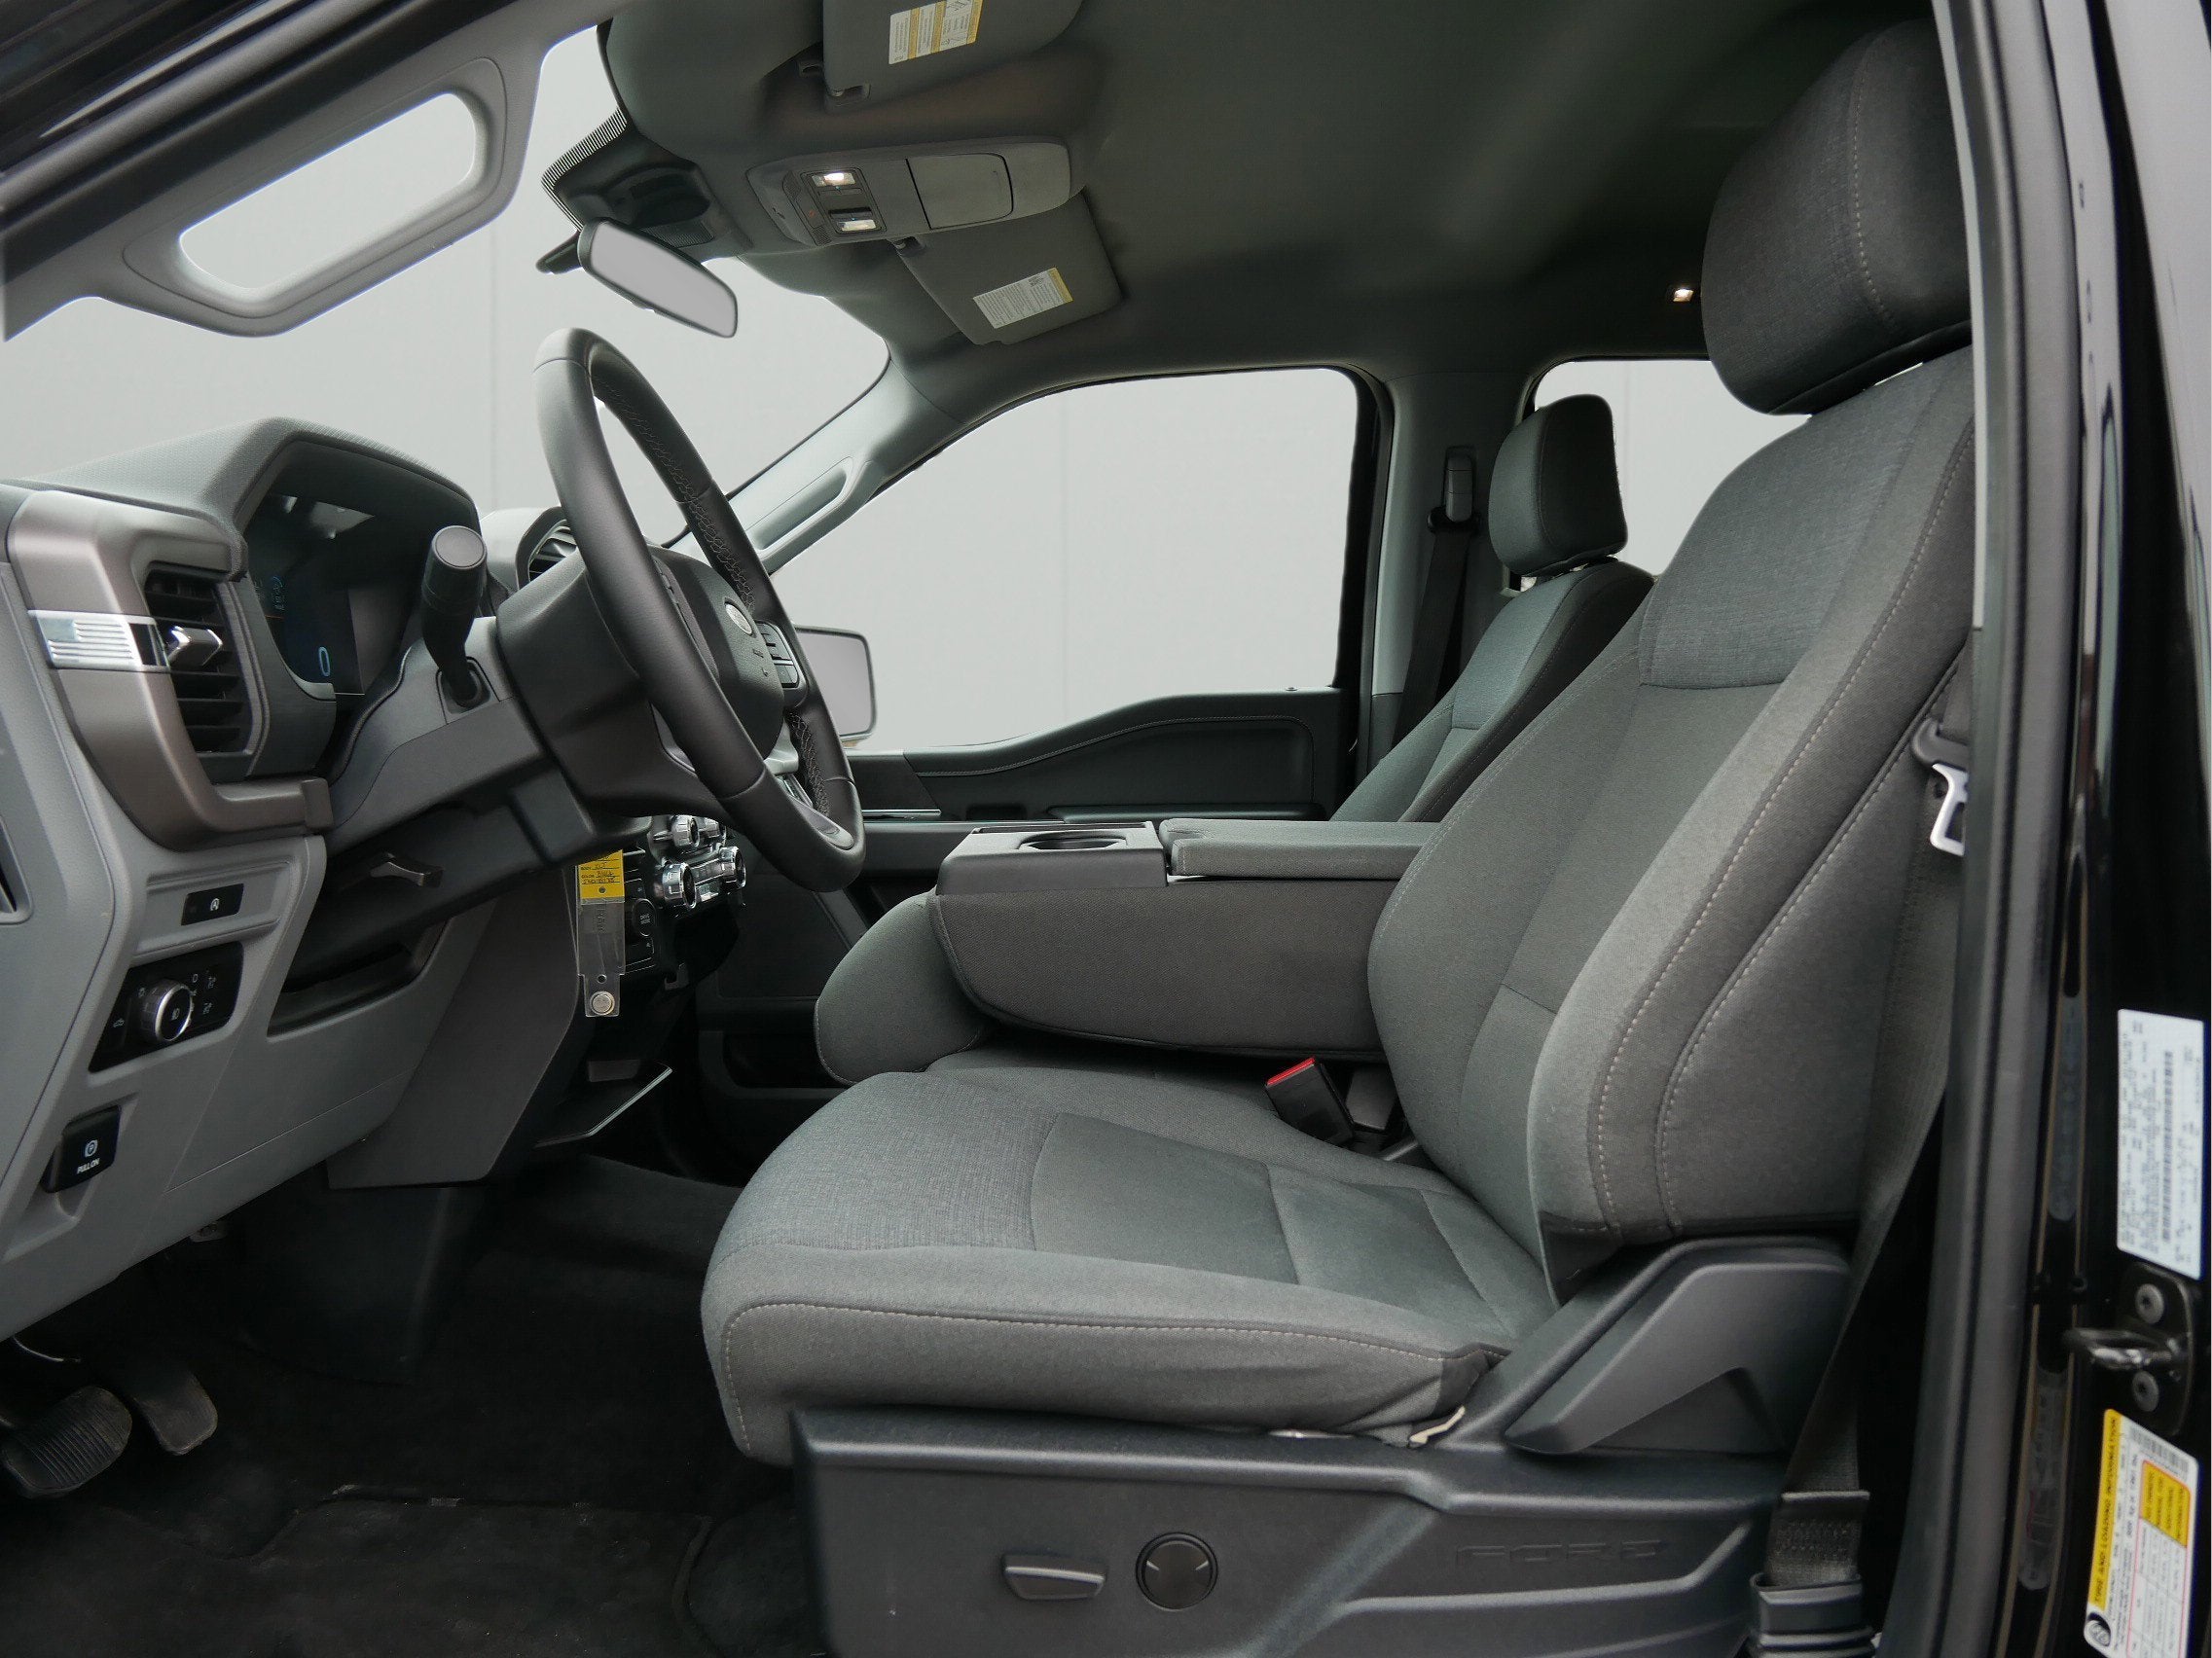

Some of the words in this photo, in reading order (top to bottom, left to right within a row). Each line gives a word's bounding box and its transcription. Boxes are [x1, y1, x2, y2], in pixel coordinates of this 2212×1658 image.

[318, 646, 331, 676] 0
[77, 1163, 91, 1174] PULL
[91, 1158, 100, 1168] ON
[1456, 1539, 1669, 1568] FORD
